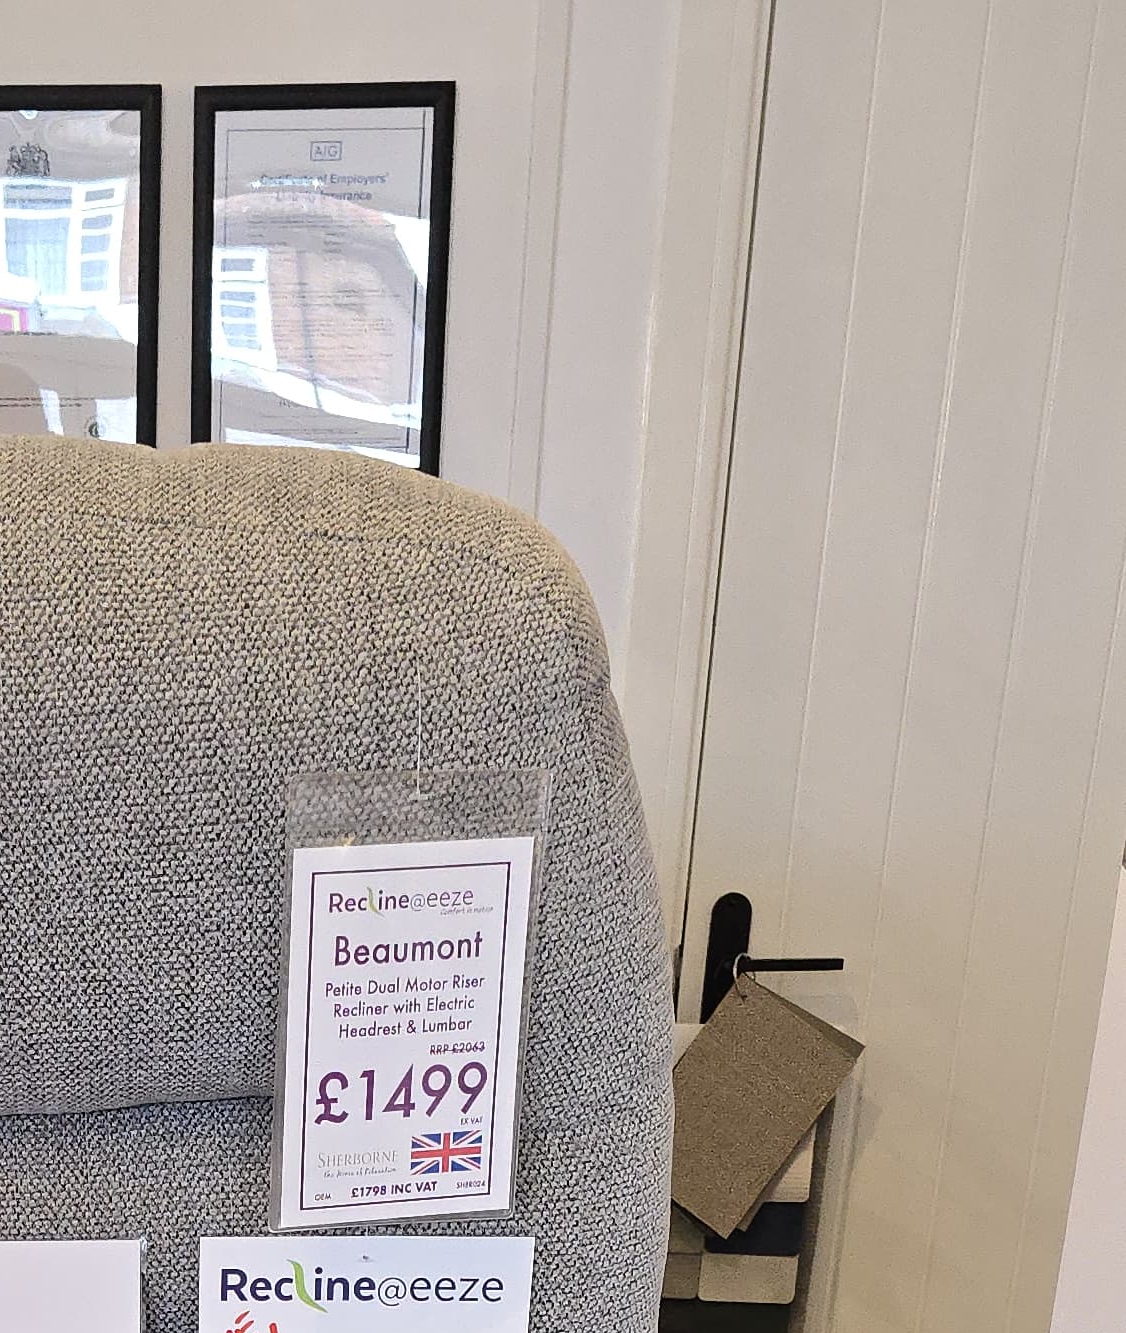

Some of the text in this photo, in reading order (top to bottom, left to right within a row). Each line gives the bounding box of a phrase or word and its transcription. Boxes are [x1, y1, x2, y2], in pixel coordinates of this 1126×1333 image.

[335, 931, 483, 967] Beaumont
[325, 974, 485, 998] Petite Dual Motor Riser
[333, 995, 475, 1018] Recliner with Electric
[338, 1016, 472, 1039] Headrest & Lumbar
[314, 1061, 488, 1126] £1499
[317, 1150, 398, 1168] SHERBORNE
[351, 1185, 387, 1198] £1798
[390, 1182, 412, 1195] INC
[415, 1181, 438, 1193] VAT
